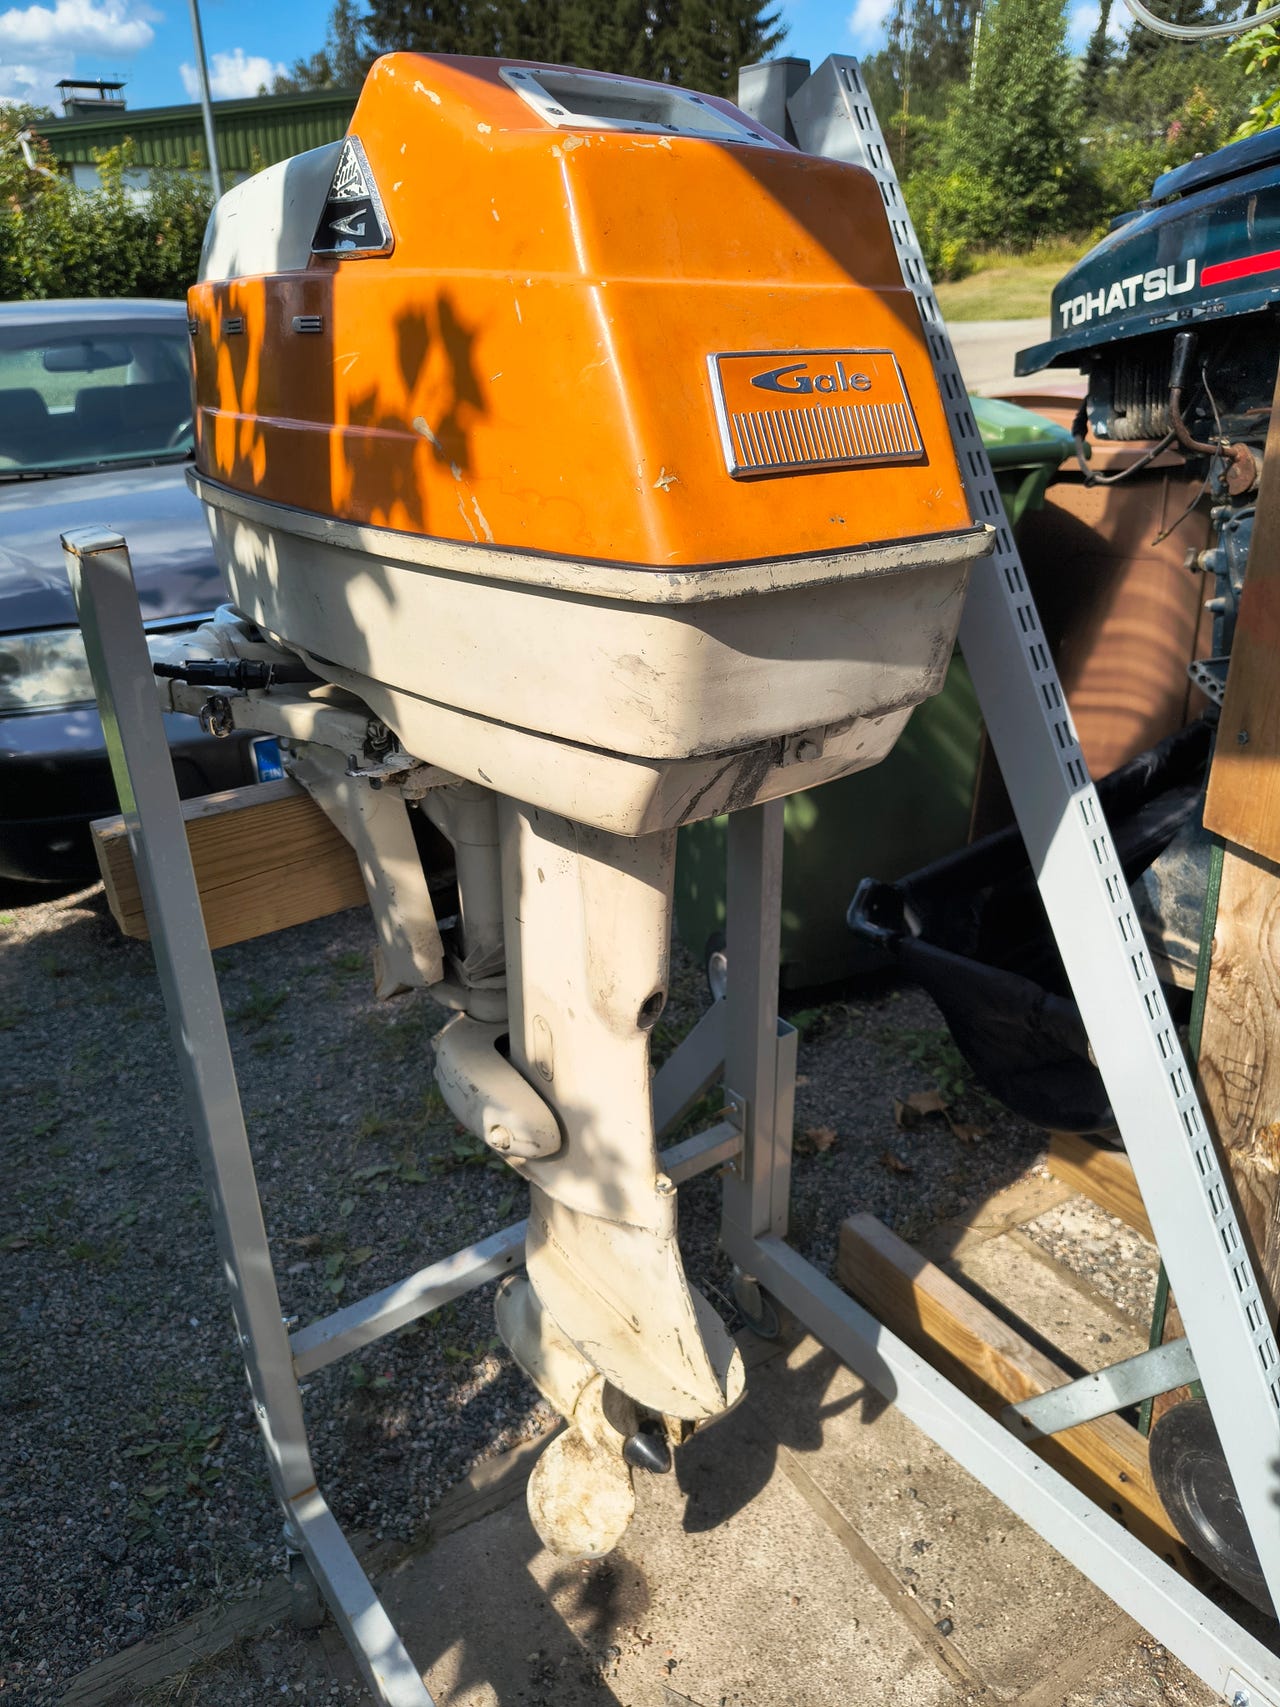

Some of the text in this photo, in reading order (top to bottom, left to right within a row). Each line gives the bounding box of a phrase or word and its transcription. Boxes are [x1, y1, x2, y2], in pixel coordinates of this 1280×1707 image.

[1059, 258, 1196, 330] TOHATSU
[750, 361, 872, 394] Gale
[261, 767, 282, 781] FIN
